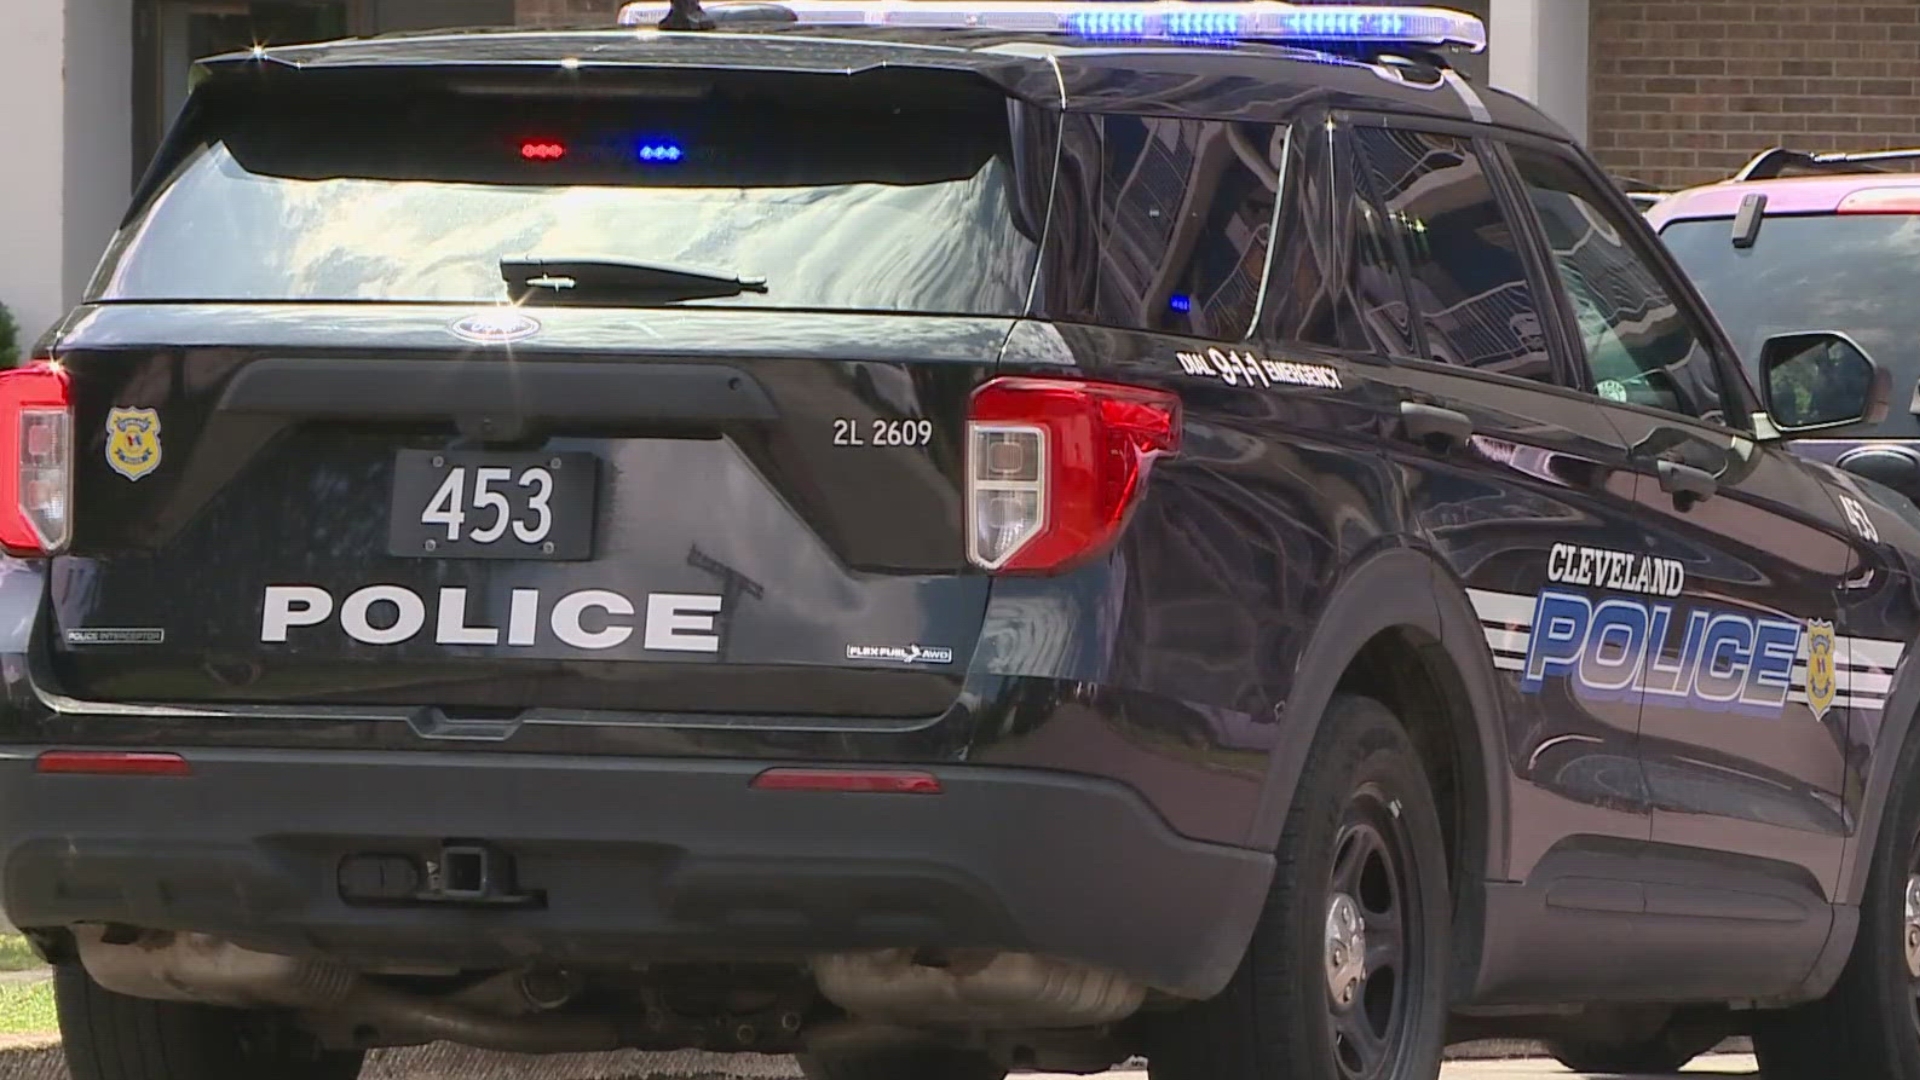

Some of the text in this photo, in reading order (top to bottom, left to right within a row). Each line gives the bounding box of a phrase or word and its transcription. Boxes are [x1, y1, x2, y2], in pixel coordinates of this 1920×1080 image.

[1176, 352, 1217, 376] DIAL
[1260, 359, 1343, 389] EMERGENCY
[833, 419, 933, 446] 2L 2609
[421, 467, 554, 544] 453
[1547, 542, 1685, 597] CLEVELAND
[260, 584, 724, 654] POLICE
[921, 649, 950, 660] AWD
[1522, 588, 1802, 718] POLICE
